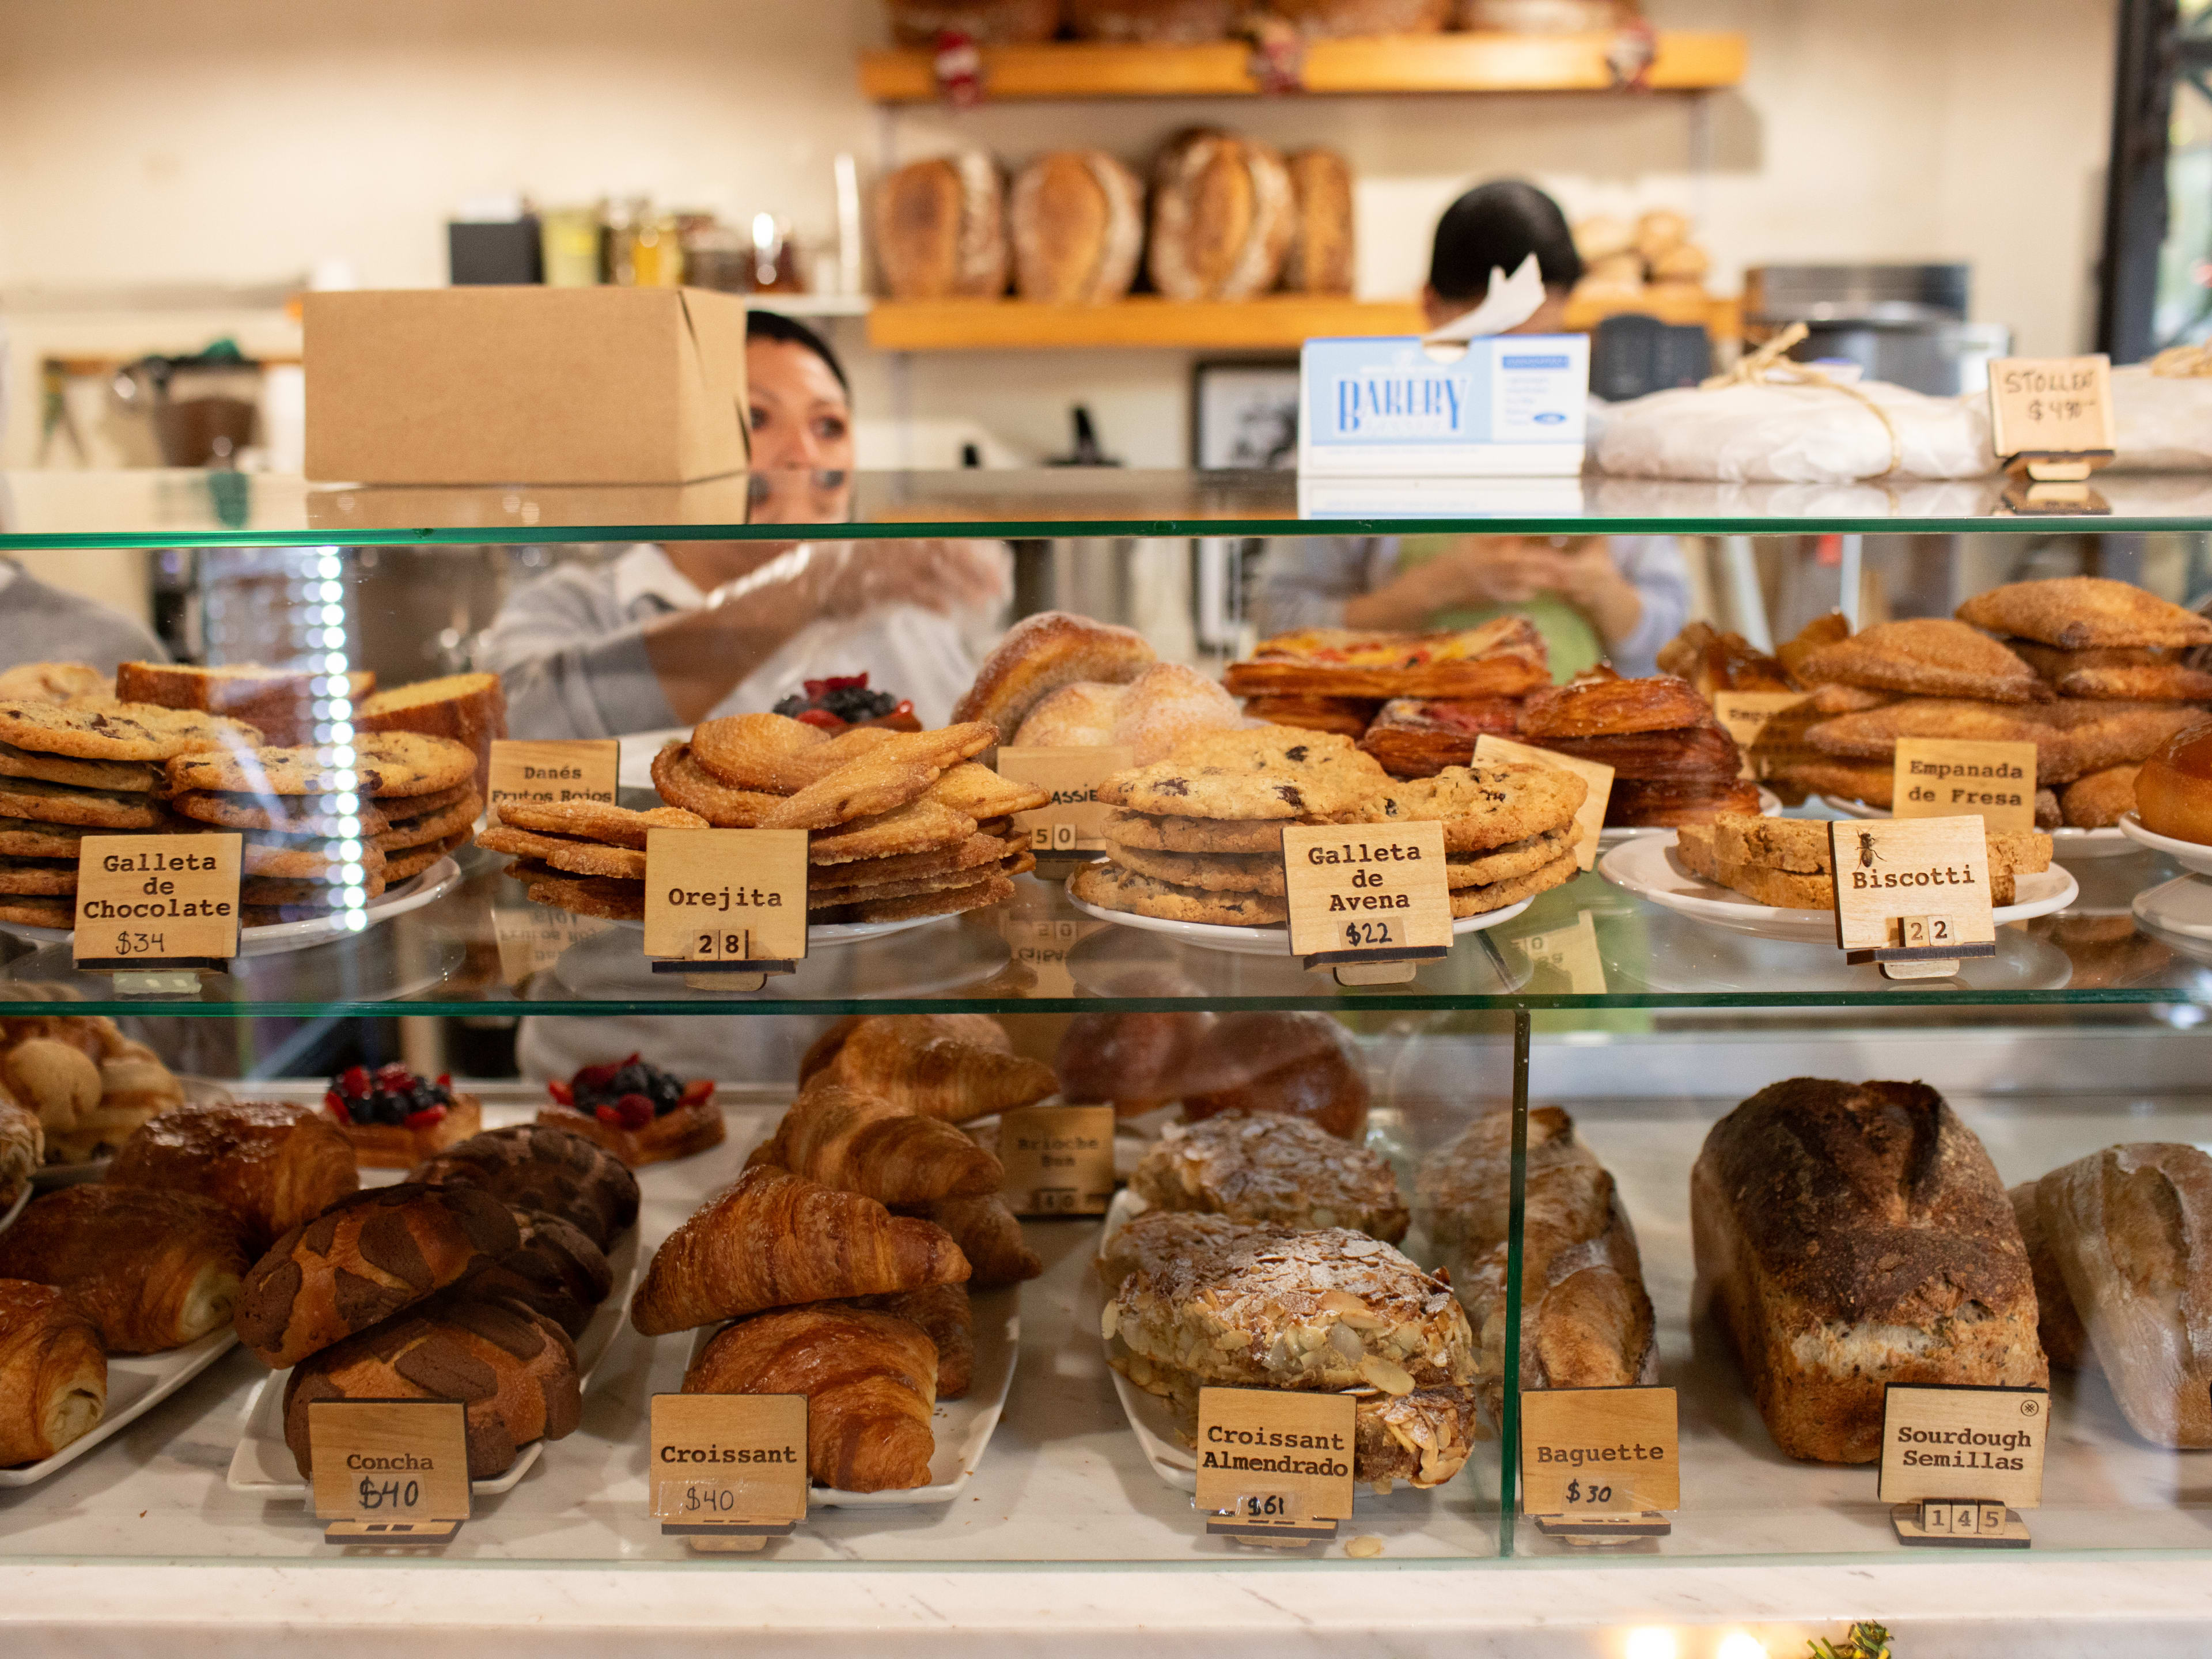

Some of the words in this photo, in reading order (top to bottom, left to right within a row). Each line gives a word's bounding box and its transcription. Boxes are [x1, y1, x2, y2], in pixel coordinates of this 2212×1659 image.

[1339, 379, 1467, 431] BAKERY
[524, 765, 582, 779] Danés
[1910, 760, 2023, 779] Empanada
[1908, 786, 1936, 802] de
[1951, 789, 2022, 806] Fresa
[1036, 828, 1071, 843] 50
[103, 853, 217, 872] Galleta
[1308, 843, 1422, 865] Galleta
[143, 877, 175, 895] de
[1352, 869, 1384, 888] de
[1852, 864, 1975, 889] Biscotti
[84, 899, 231, 919] Chocolate
[668, 887, 782, 911] Orejita
[1329, 894, 1410, 912] Avena
[1345, 922, 1393, 946] $22
[1910, 920, 1948, 941] 22
[115, 931, 165, 955] $34
[699, 934, 739, 954] 28
[1207, 1426, 1345, 1451] Croissant
[1897, 1427, 2032, 1451] Sourdough
[346, 1453, 434, 1470] Concha
[660, 1444, 797, 1464] Croissant
[1202, 1450, 1349, 1477] Almendrado
[1537, 1444, 1664, 1467] Baguette
[1903, 1450, 2024, 1471] Semillas
[358, 1475, 419, 1509] $40
[685, 1486, 734, 1511] $40
[1248, 1495, 1284, 1516] $61
[1931, 1509, 1999, 1528] 145
